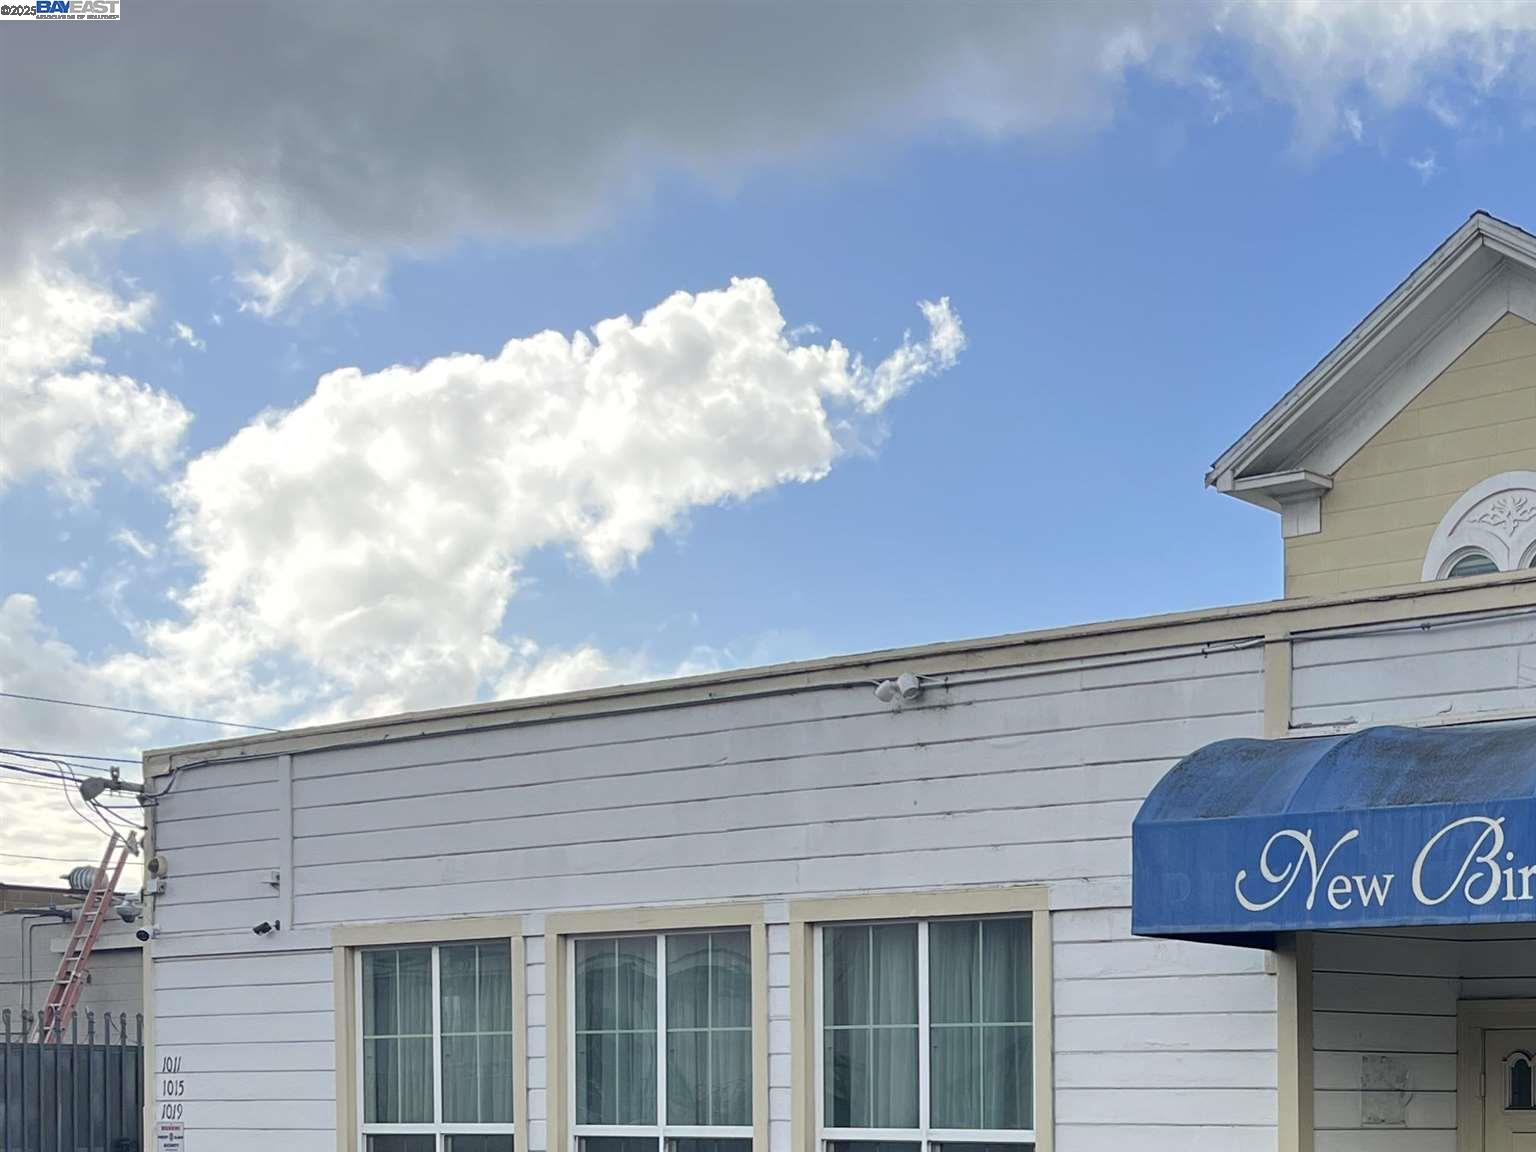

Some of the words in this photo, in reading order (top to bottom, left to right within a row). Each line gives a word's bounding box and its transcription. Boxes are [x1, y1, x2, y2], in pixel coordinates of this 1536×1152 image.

[1235, 828, 1394, 911] New
[162, 1056, 181, 1073] 1011
[163, 1080, 184, 1096] 1015
[161, 1104, 183, 1120] 1019
